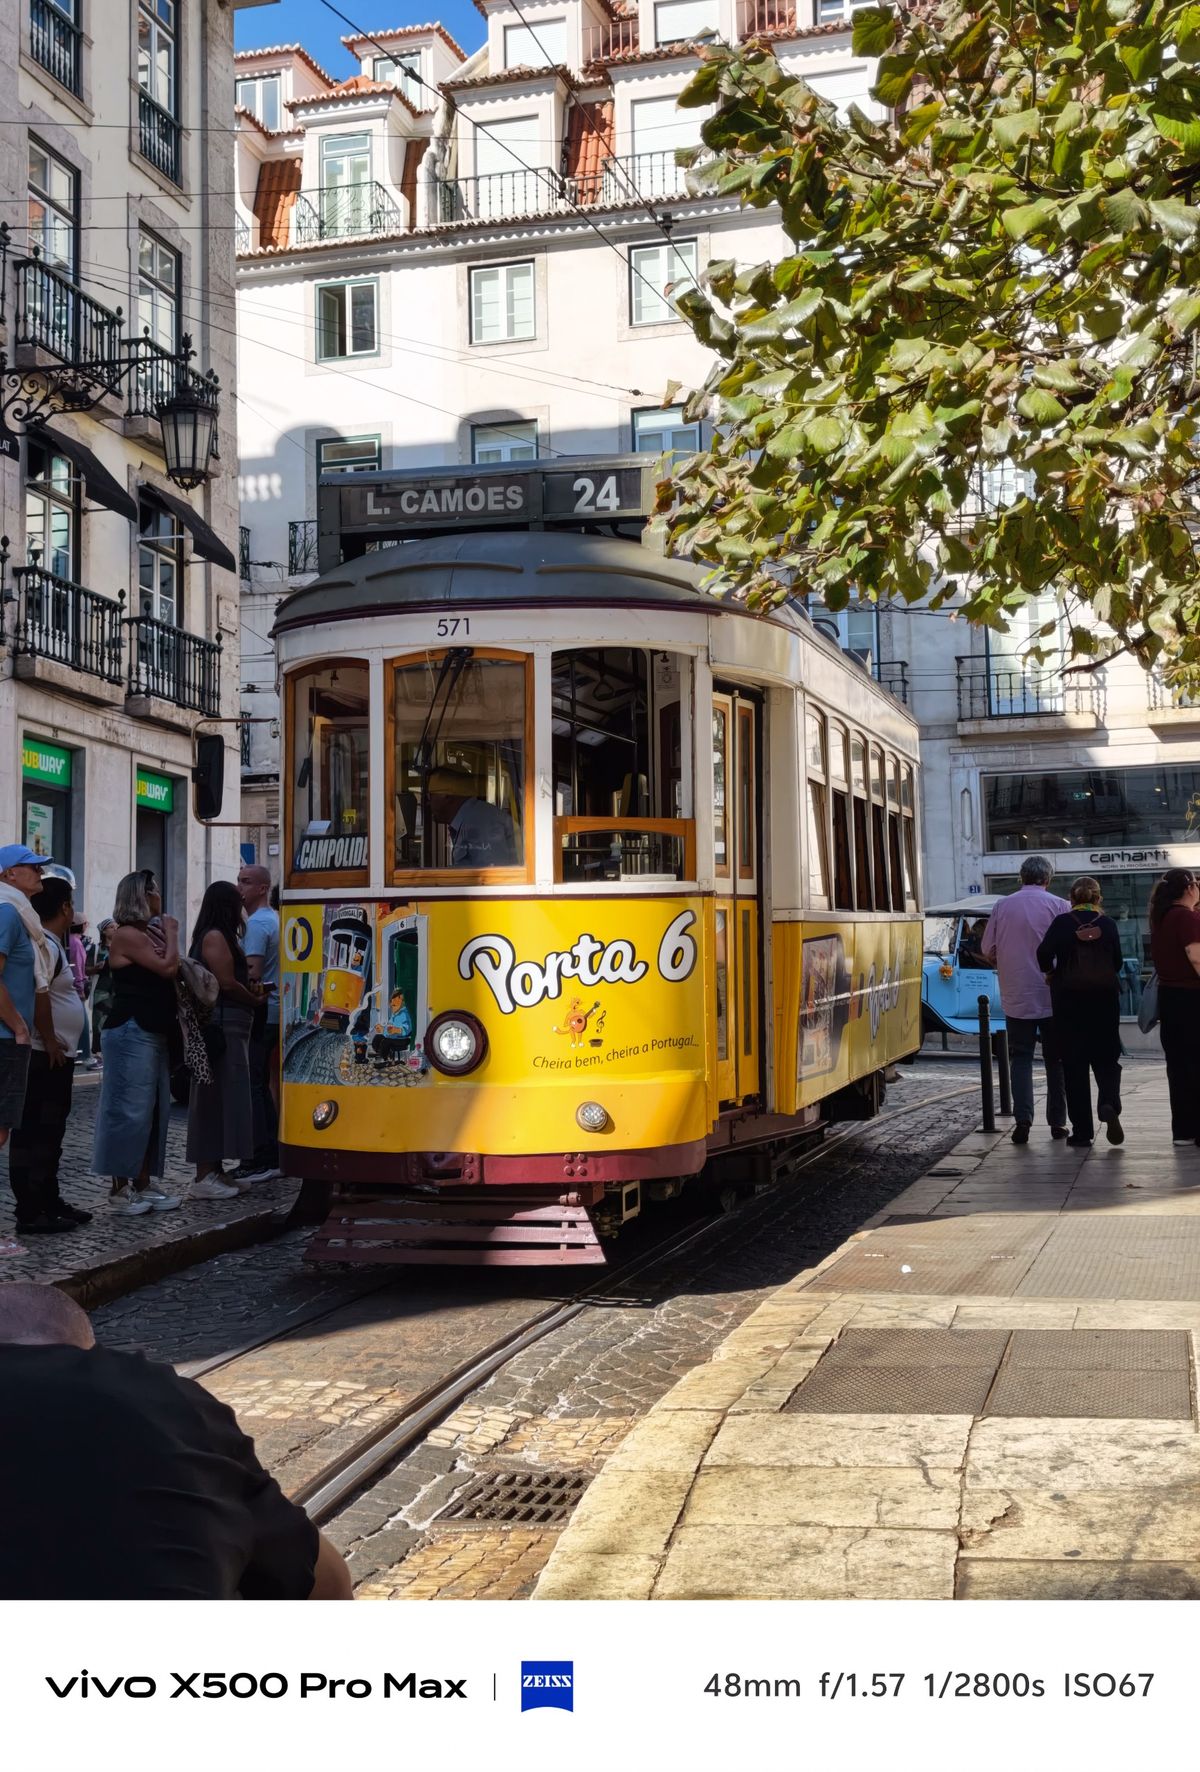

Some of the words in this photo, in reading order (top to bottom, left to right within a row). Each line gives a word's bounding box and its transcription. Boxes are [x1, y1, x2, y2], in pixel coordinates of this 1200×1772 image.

[366, 491, 391, 515] L.
[572, 475, 620, 513] 24
[437, 617, 470, 637] 571
[1090, 849, 1170, 863] carhartt
[458, 934, 650, 1014] Porta
[657, 909, 697, 982] 6
[532, 1056, 572, 1070] Cheira
[575, 1054, 604, 1068] bem,
[606, 1048, 640, 1062] cheira
[641, 1043, 649, 1053] a
